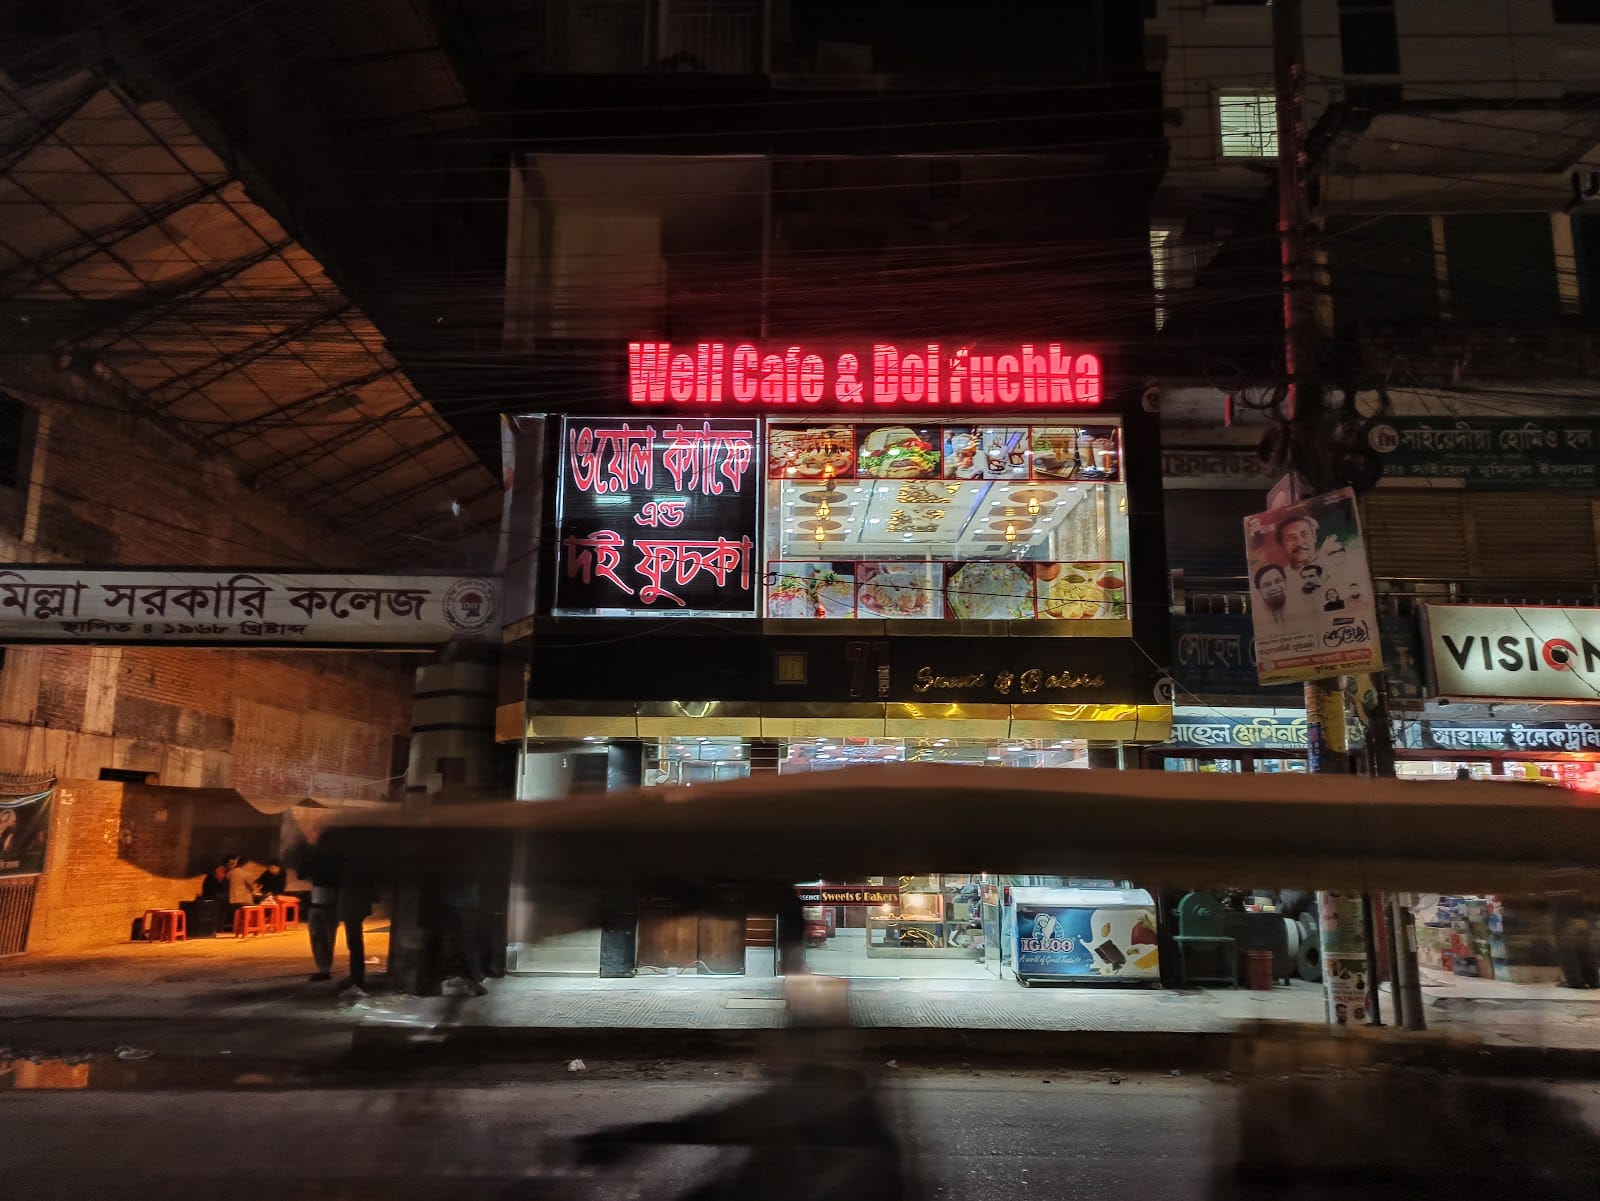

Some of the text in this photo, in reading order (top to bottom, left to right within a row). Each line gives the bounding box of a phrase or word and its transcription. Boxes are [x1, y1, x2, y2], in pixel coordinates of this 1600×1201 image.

[630, 343, 723, 402] Well
[733, 344, 824, 402] Cafe
[836, 354, 862, 402] &
[663, 421, 753, 495] ক্যাফে
[633, 502, 686, 528] এন্ড
[564, 530, 754, 606] দই ফুচকা
[100, 574, 273, 619] সরকারি
[285, 587, 432, 621] কলেজ
[163, 623, 229, 635] ১৯৬৮
[1178, 632, 1242, 669] সোহেল
[822, 892, 854, 902] Sweets
[1022, 938, 1074, 953] IGLOO
